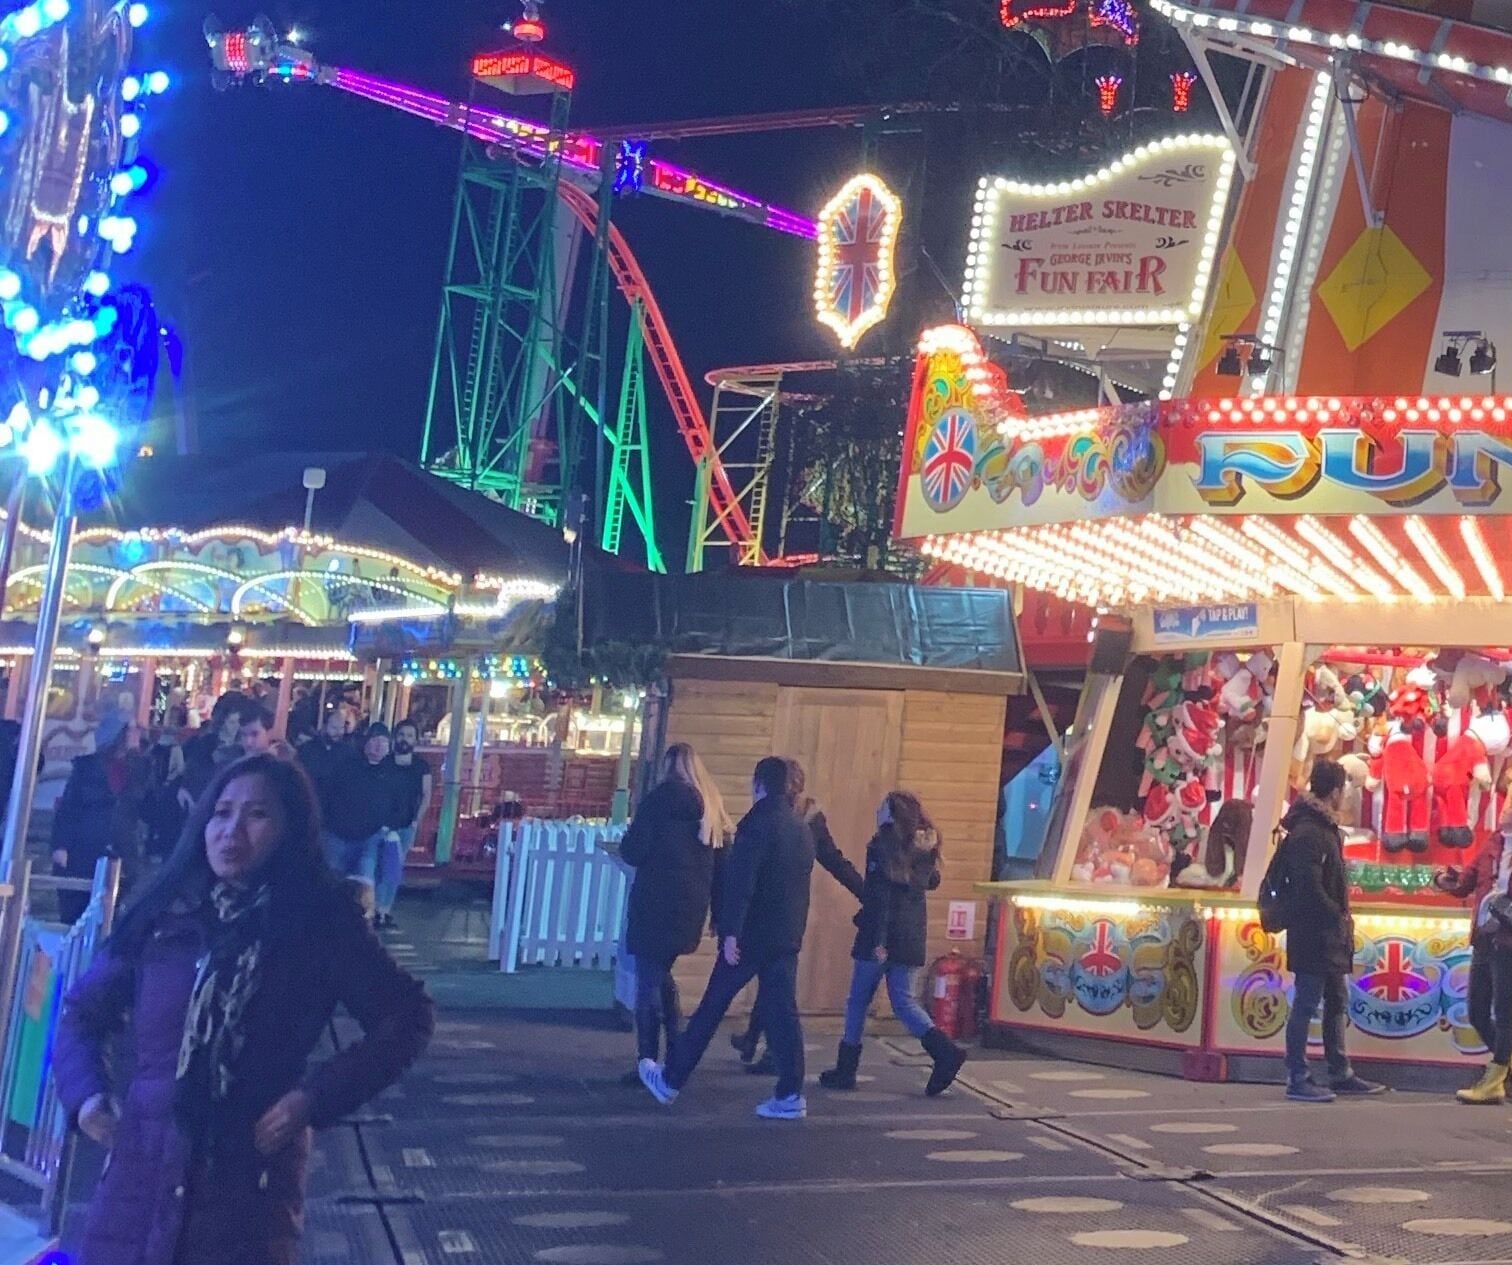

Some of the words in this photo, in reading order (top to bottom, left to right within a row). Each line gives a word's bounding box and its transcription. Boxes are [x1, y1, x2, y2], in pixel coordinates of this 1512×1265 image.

[1009, 201, 1094, 233] HELTER
[1102, 200, 1197, 229] SKELTER
[1014, 257, 1080, 295] FUN
[1086, 255, 1168, 296] FAIR
[1050, 253, 1091, 266] GEORGE
